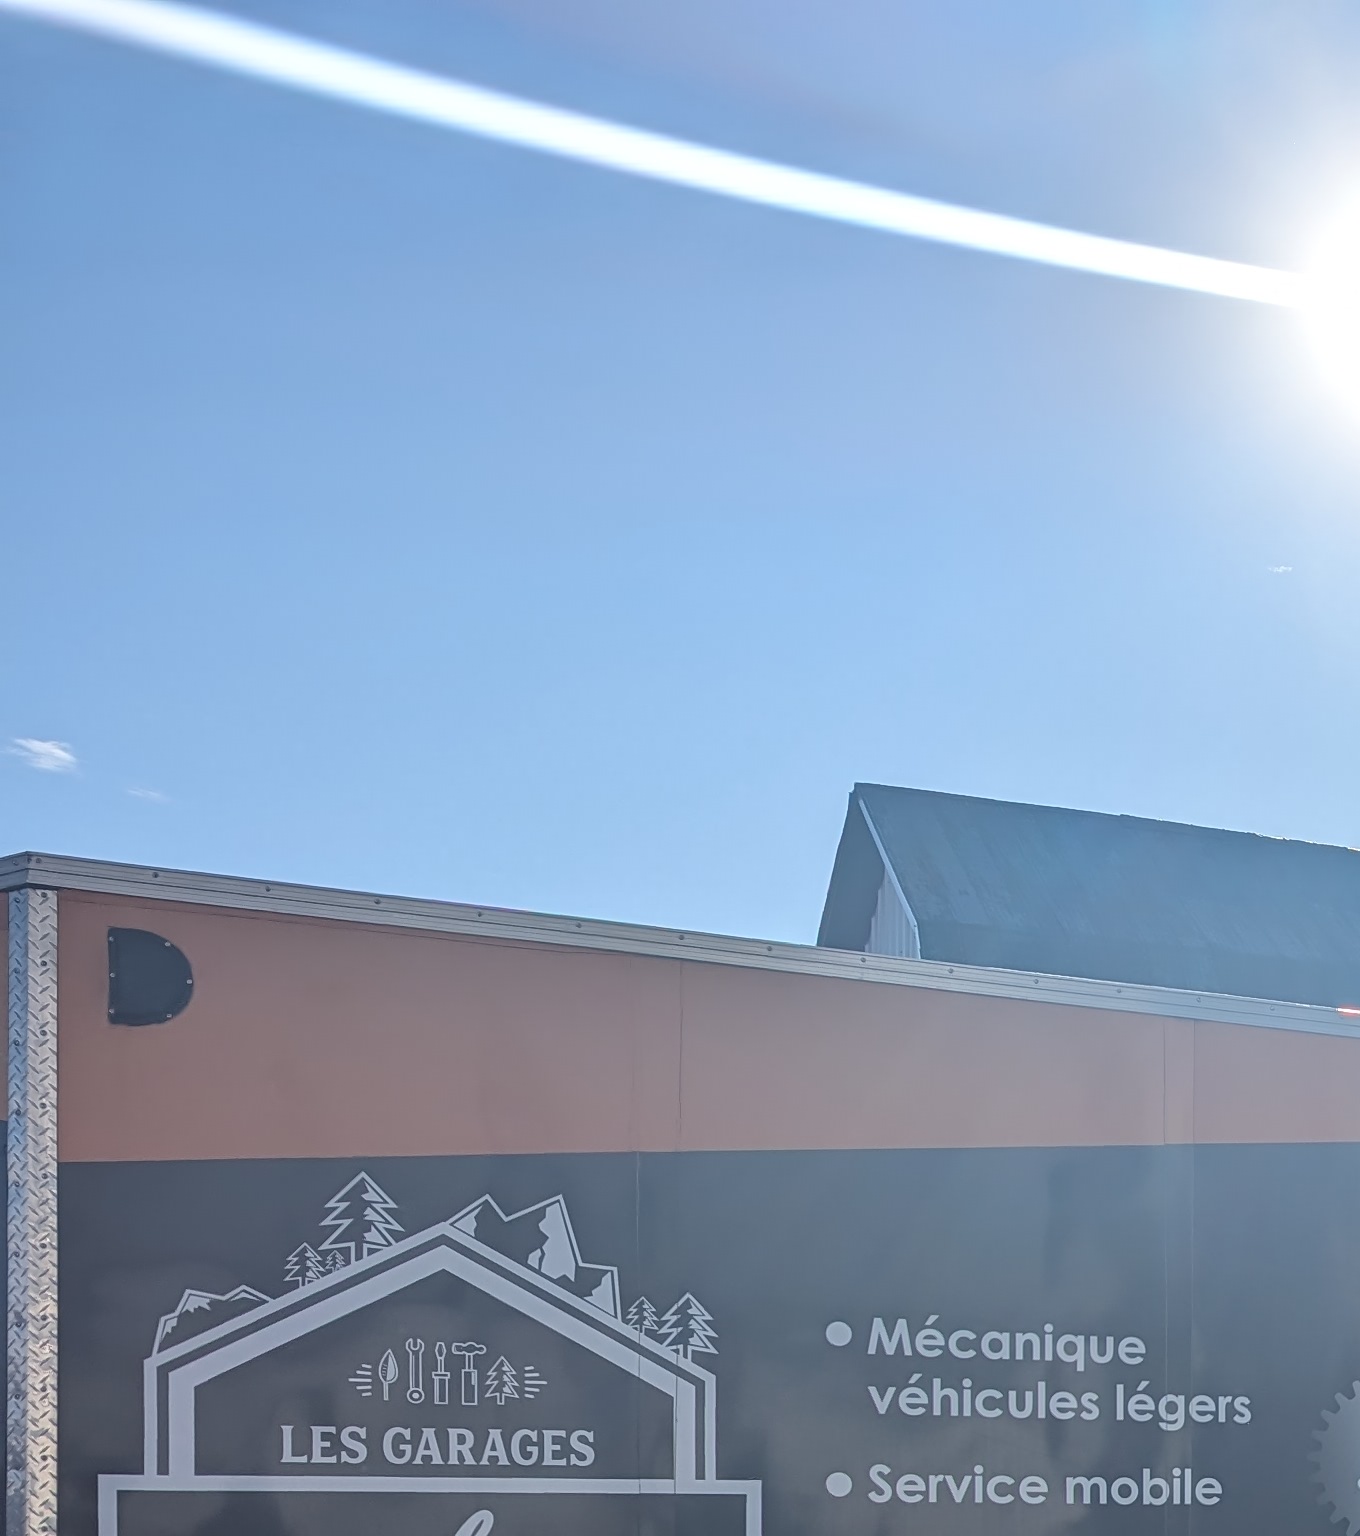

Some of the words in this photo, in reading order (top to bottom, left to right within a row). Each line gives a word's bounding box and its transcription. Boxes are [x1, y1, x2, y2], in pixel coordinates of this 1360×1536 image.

[867, 1315, 1146, 1371] Mécanique
[868, 1374, 1099, 1420] véhicules
[1115, 1381, 1252, 1431] légers
[280, 1424, 367, 1465] LES
[382, 1427, 595, 1467] GARAGES
[867, 1464, 1048, 1504] Service
[1065, 1468, 1223, 1506] mobile
